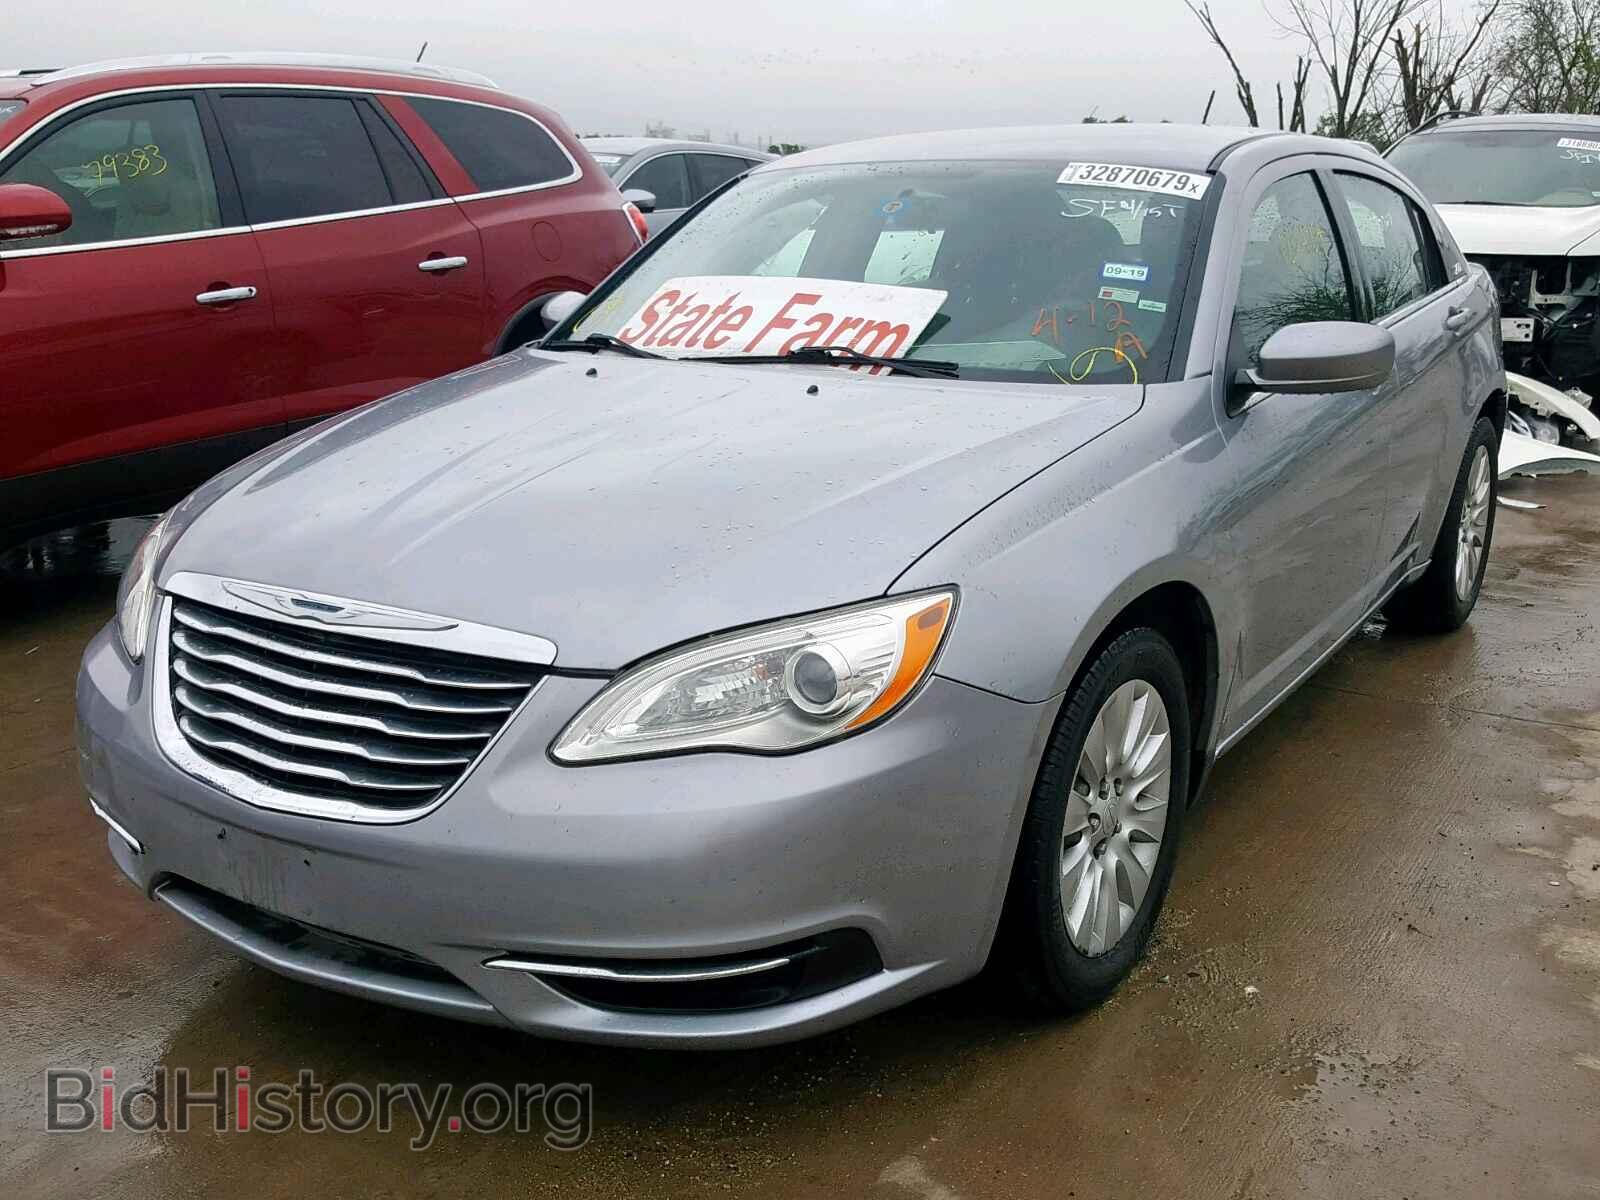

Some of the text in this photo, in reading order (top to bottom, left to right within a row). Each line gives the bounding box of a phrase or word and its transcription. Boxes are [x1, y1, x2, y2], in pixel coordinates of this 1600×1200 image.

[1105, 266, 1146, 278] 09-19
[619, 289, 911, 375] State Farm
